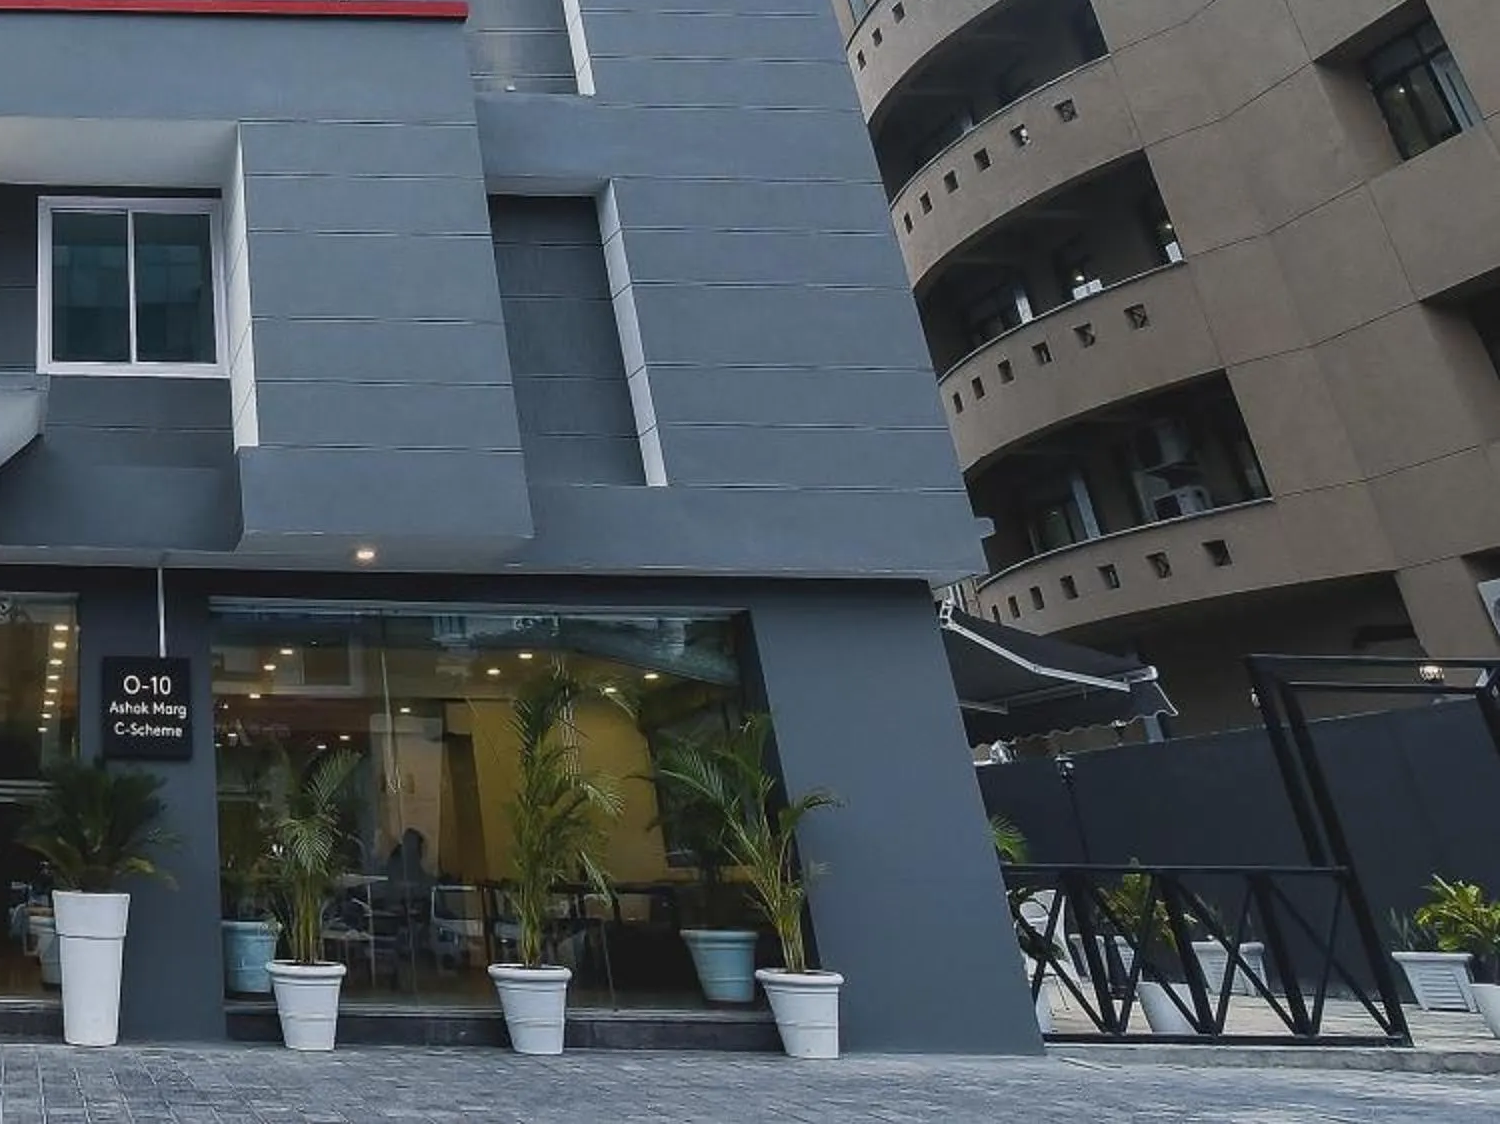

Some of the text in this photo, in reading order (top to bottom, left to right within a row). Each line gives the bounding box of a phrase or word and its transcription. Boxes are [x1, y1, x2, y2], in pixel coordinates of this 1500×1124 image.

[123, 675, 172, 695] O-10
[109, 701, 187, 719] Ashok Marg
[114, 721, 183, 737] C-Scheme
